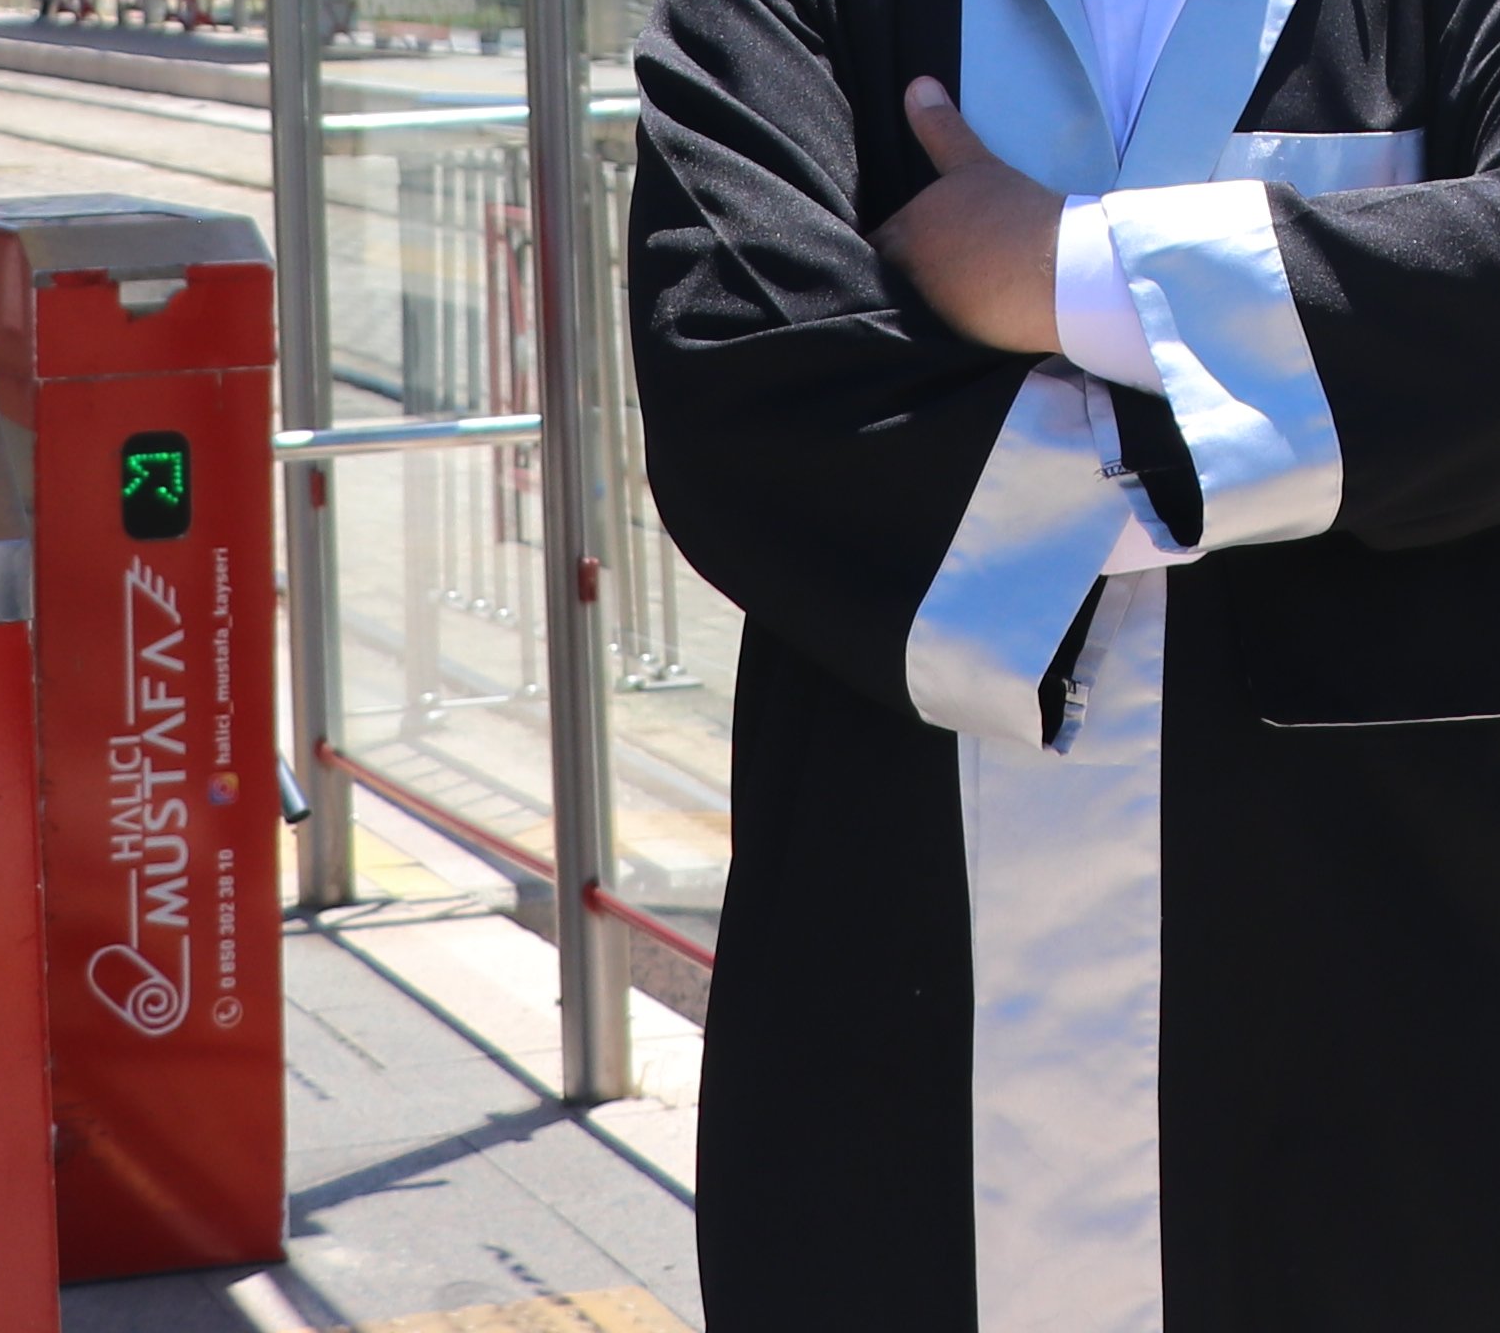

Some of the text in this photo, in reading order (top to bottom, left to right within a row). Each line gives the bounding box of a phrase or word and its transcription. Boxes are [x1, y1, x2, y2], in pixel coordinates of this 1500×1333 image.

[213, 547, 235, 766] halici_mustafa_kayseri
[109, 735, 144, 861] HALICI
[140, 629, 190, 927] MUSTAFA
